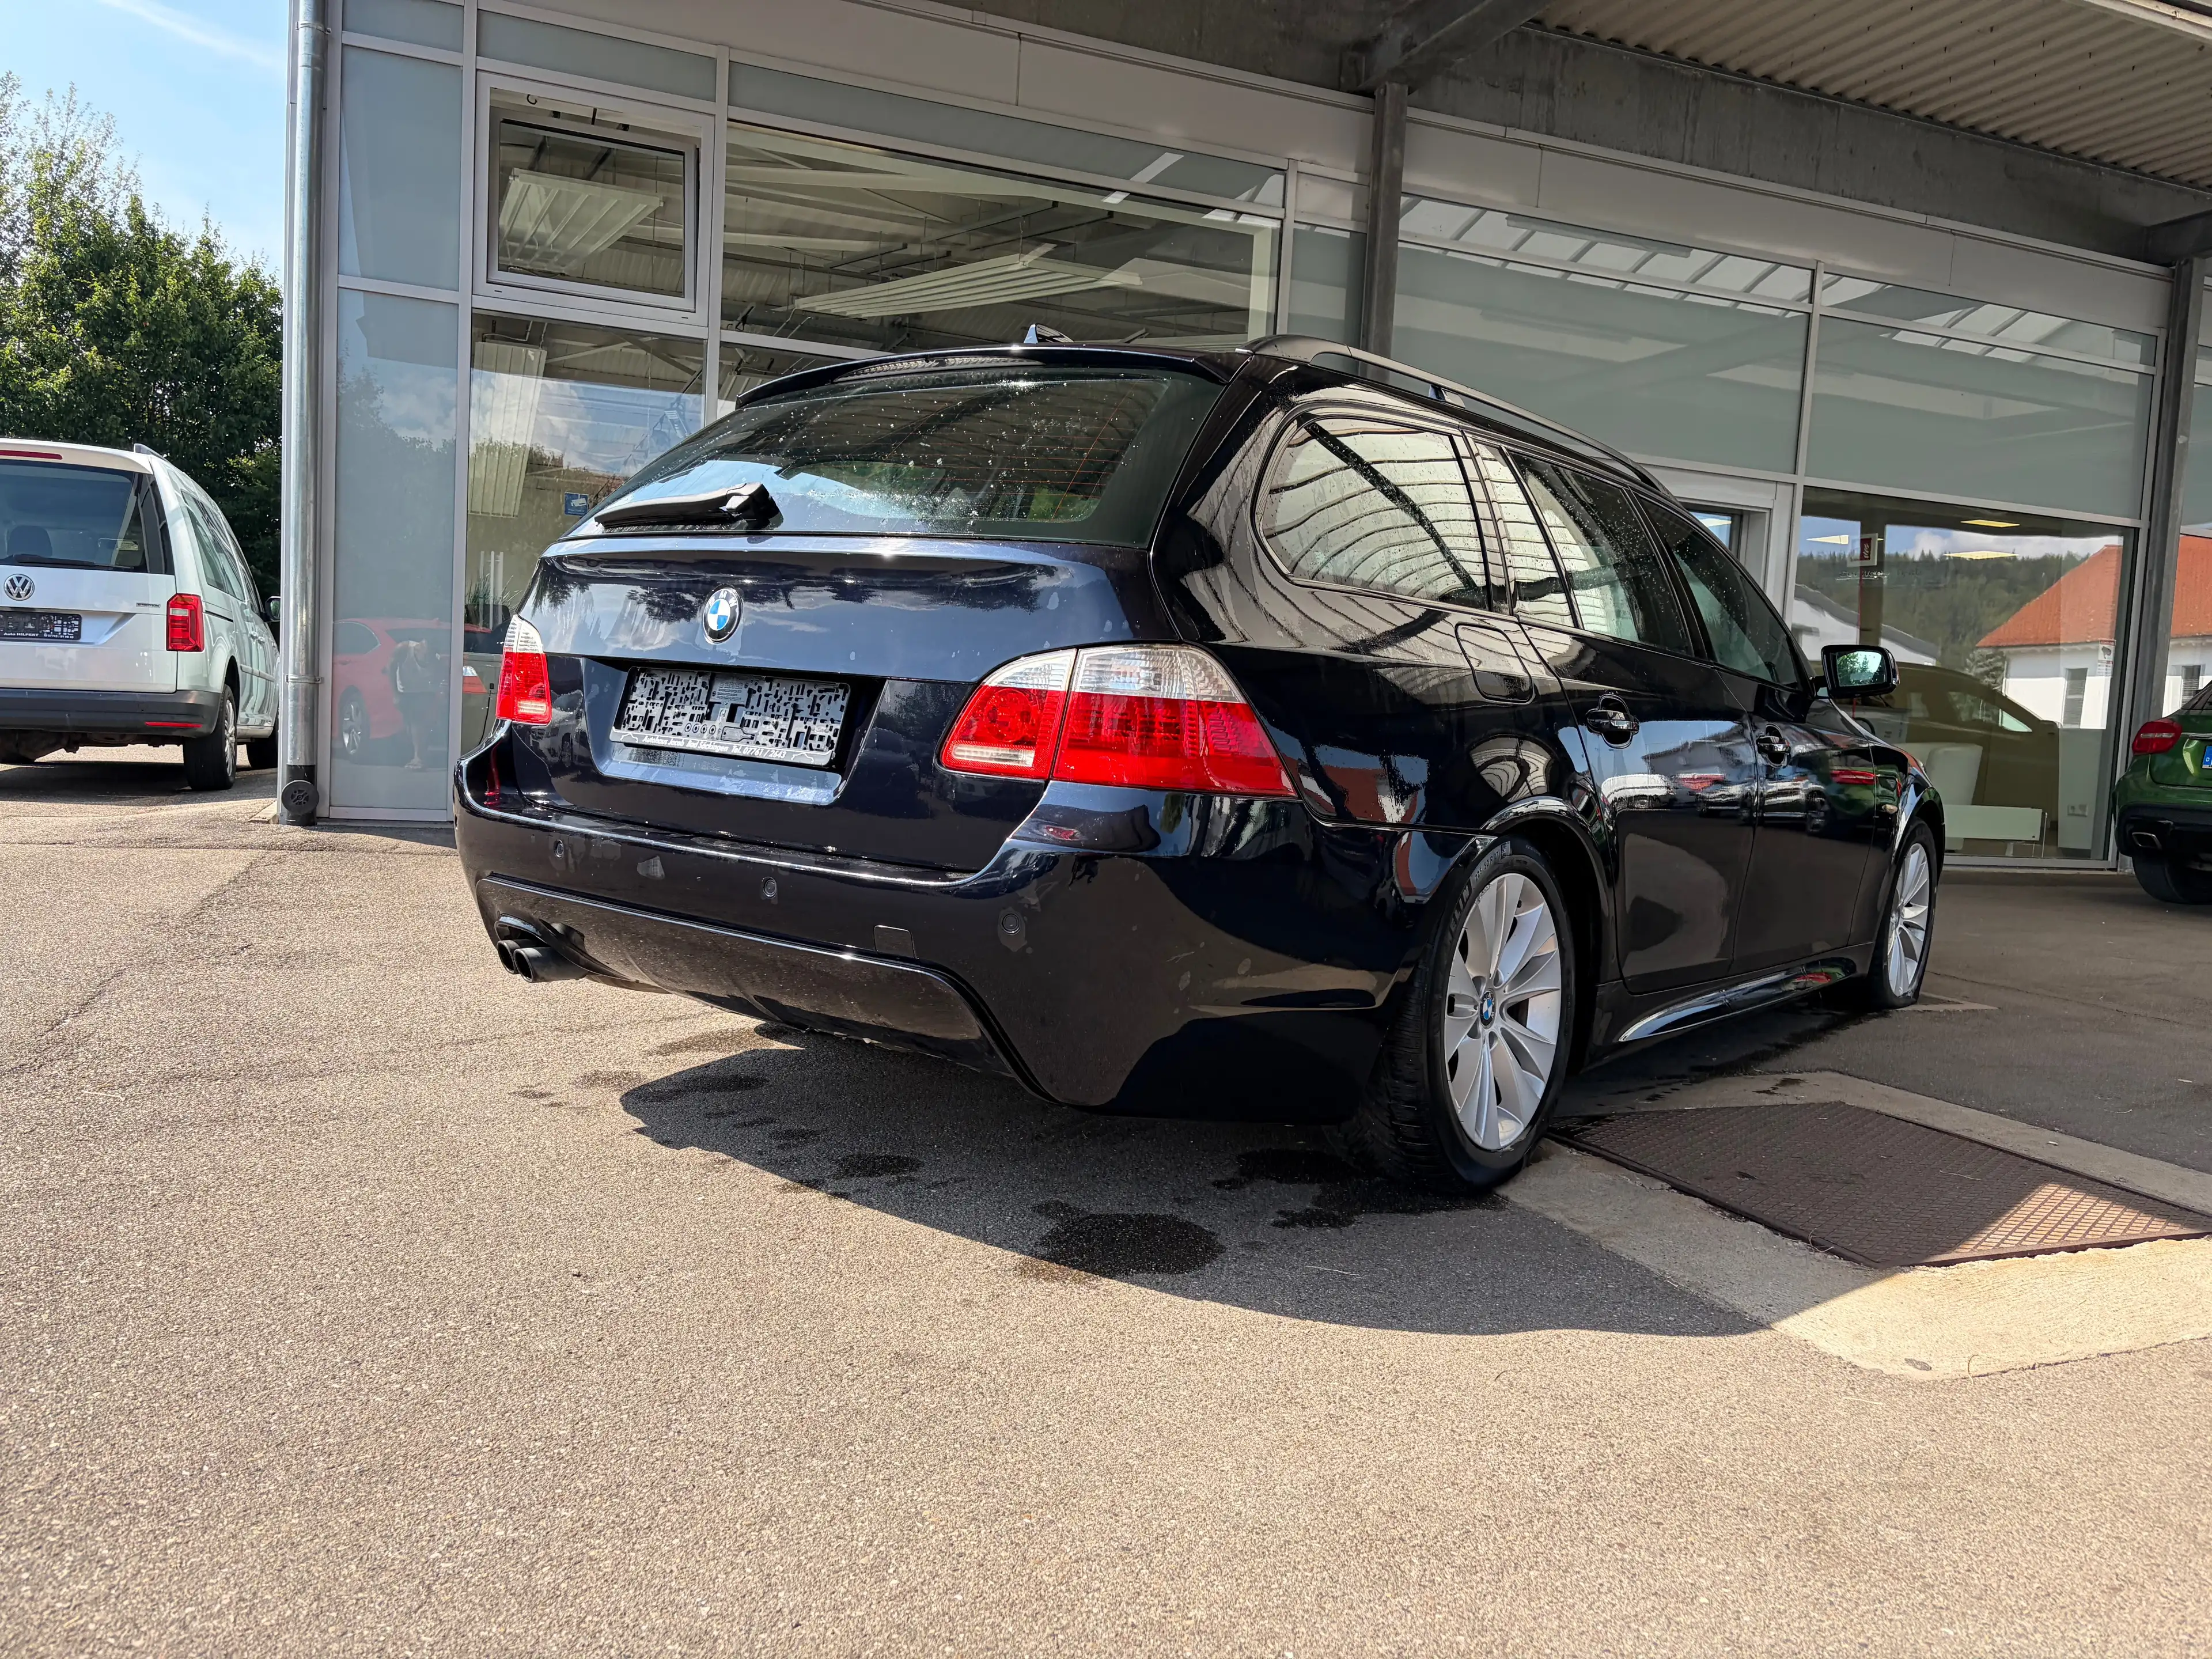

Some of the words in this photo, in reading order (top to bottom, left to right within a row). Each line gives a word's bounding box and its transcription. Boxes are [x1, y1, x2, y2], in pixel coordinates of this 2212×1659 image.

[706, 589, 738, 608] BMW
[642, 736, 669, 745] Autohaus
[668, 738, 685, 747] Jacob
[685, 740, 699, 748] Bad
[731, 745, 741, 753] Tel.
[743, 748, 764, 756] 07761
[768, 750, 787, 759] 2643
